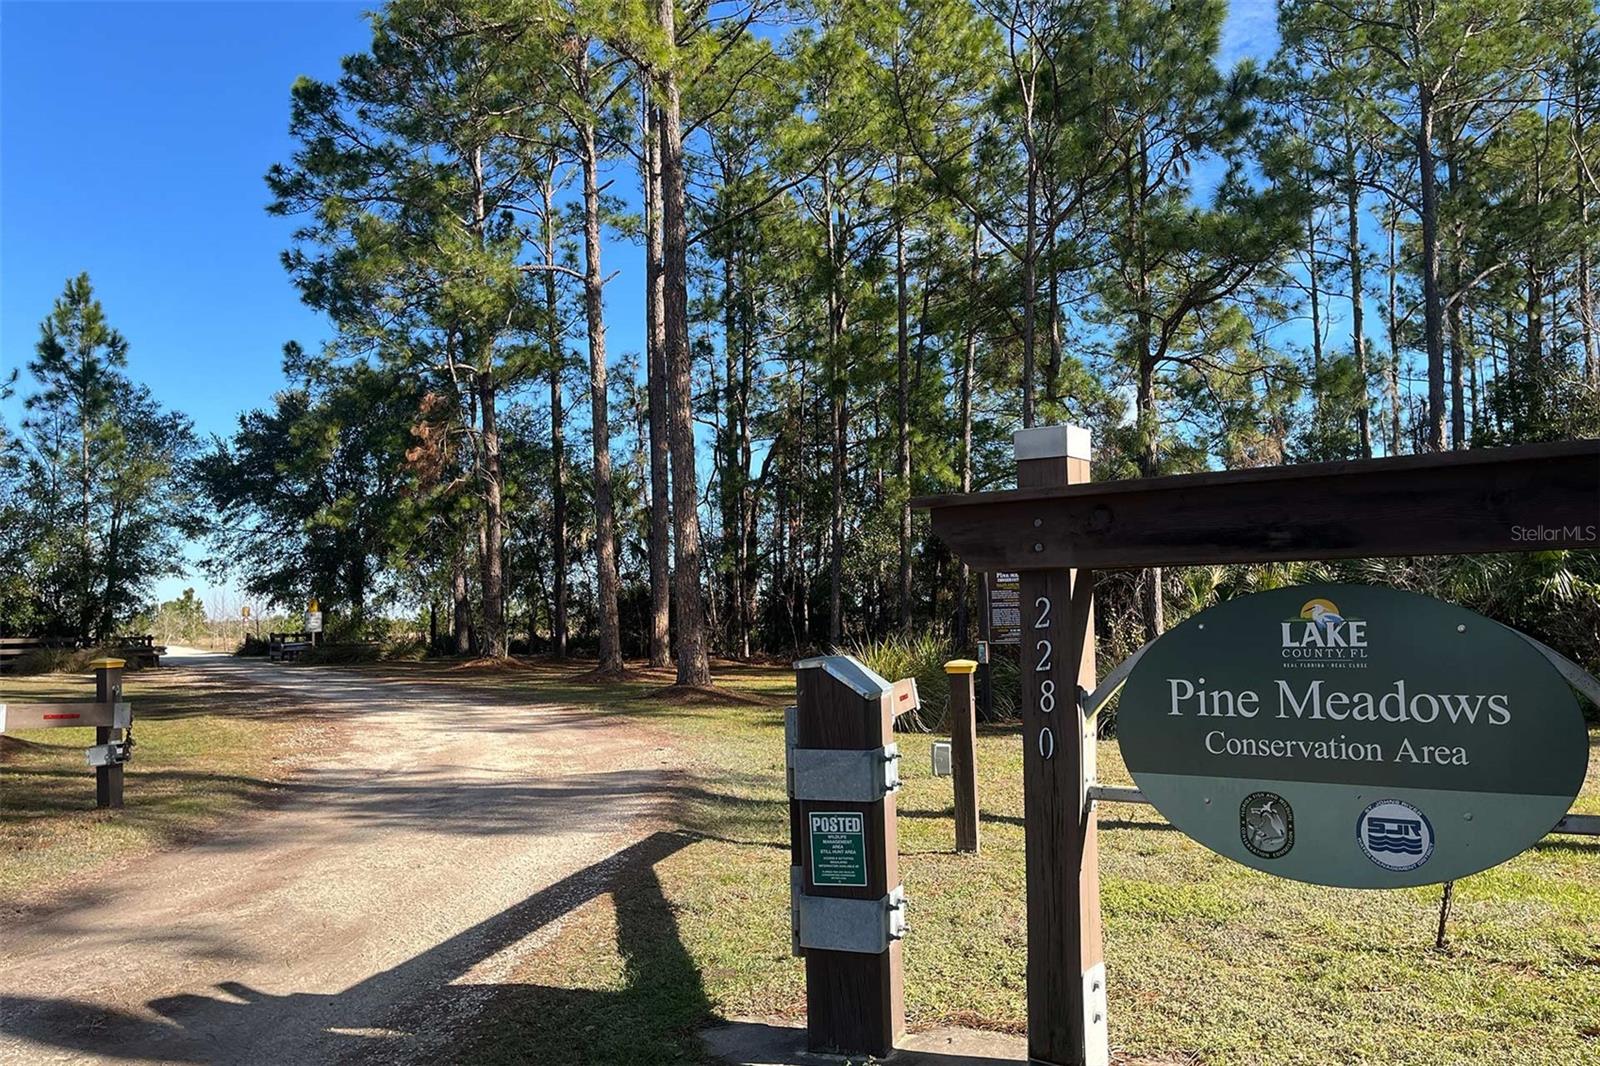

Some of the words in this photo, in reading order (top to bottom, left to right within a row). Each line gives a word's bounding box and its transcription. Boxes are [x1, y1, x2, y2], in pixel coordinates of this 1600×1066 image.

[1281, 621, 1368, 648] LAKE
[1350, 648, 1368, 658] FL
[1166, 678, 1260, 718] Pine
[1273, 680, 1511, 725] Meadows
[1205, 731, 1384, 761] Conservation
[1394, 738, 1470, 765] Area
[812, 816, 861, 832] POSTED
